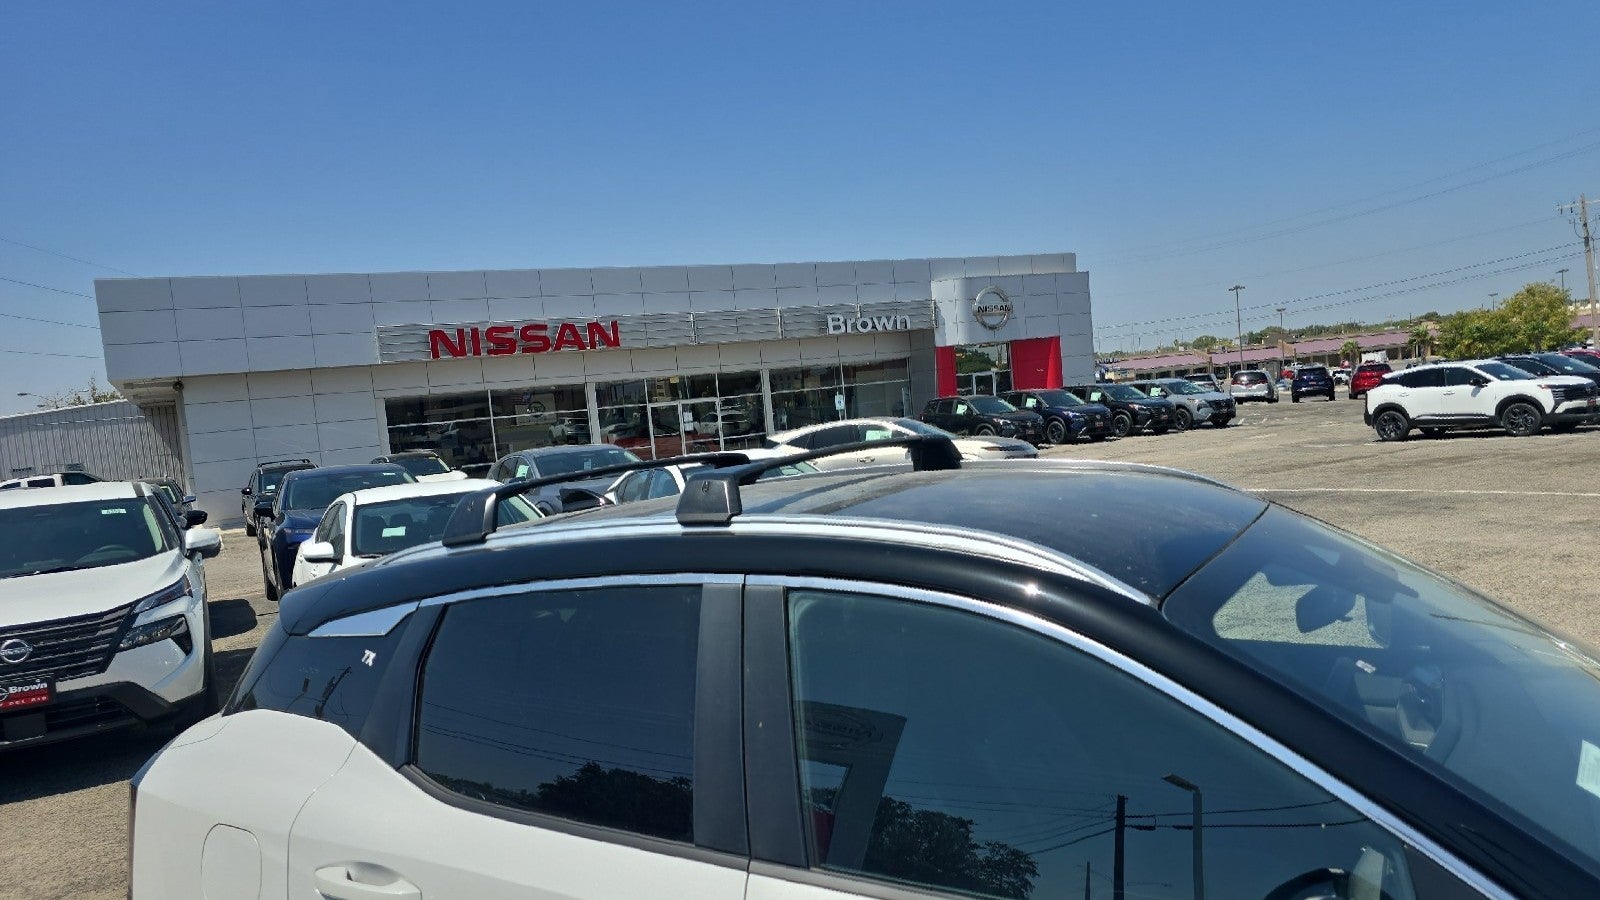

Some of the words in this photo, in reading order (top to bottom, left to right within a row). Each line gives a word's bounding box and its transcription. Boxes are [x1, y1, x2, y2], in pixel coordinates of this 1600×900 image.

[977, 305, 1010, 313] NISSAN
[827, 314, 911, 335] Brown
[428, 320, 620, 360] NISSAN
[8, 682, 48, 694] Brown
